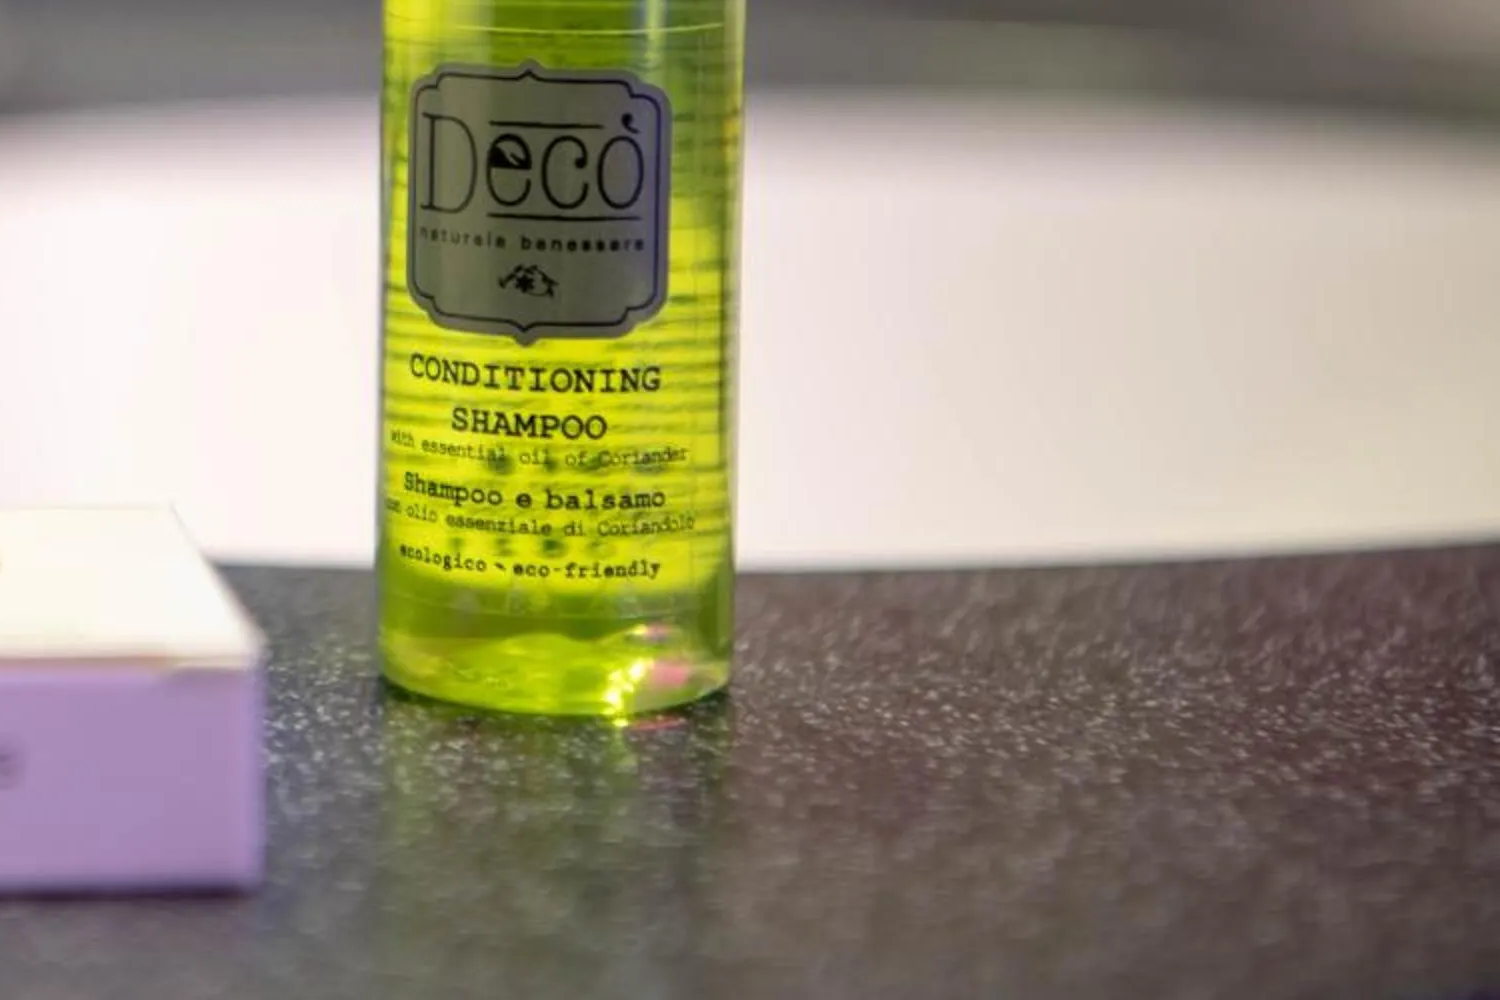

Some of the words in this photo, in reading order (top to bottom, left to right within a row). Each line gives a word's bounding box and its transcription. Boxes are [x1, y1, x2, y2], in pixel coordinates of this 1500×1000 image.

[420, 112, 645, 214] Decò
[420, 226, 507, 249] naturale
[521, 234, 645, 253] benessere
[409, 352, 662, 394] CONDITIONING
[451, 406, 609, 441] SHAMPOO
[390, 427, 416, 450] with
[421, 436, 507, 465] essential
[519, 447, 551, 467] oil
[565, 449, 587, 467] of
[598, 446, 689, 468] Coriander
[403, 471, 503, 507] Shampoo
[515, 490, 533, 509] e
[544, 487, 666, 511] balsamo
[406, 503, 438, 524] olio
[445, 513, 551, 537] essenziale
[563, 519, 585, 537] di
[400, 544, 488, 572] ecologico
[512, 558, 661, 581] eco-friendly
